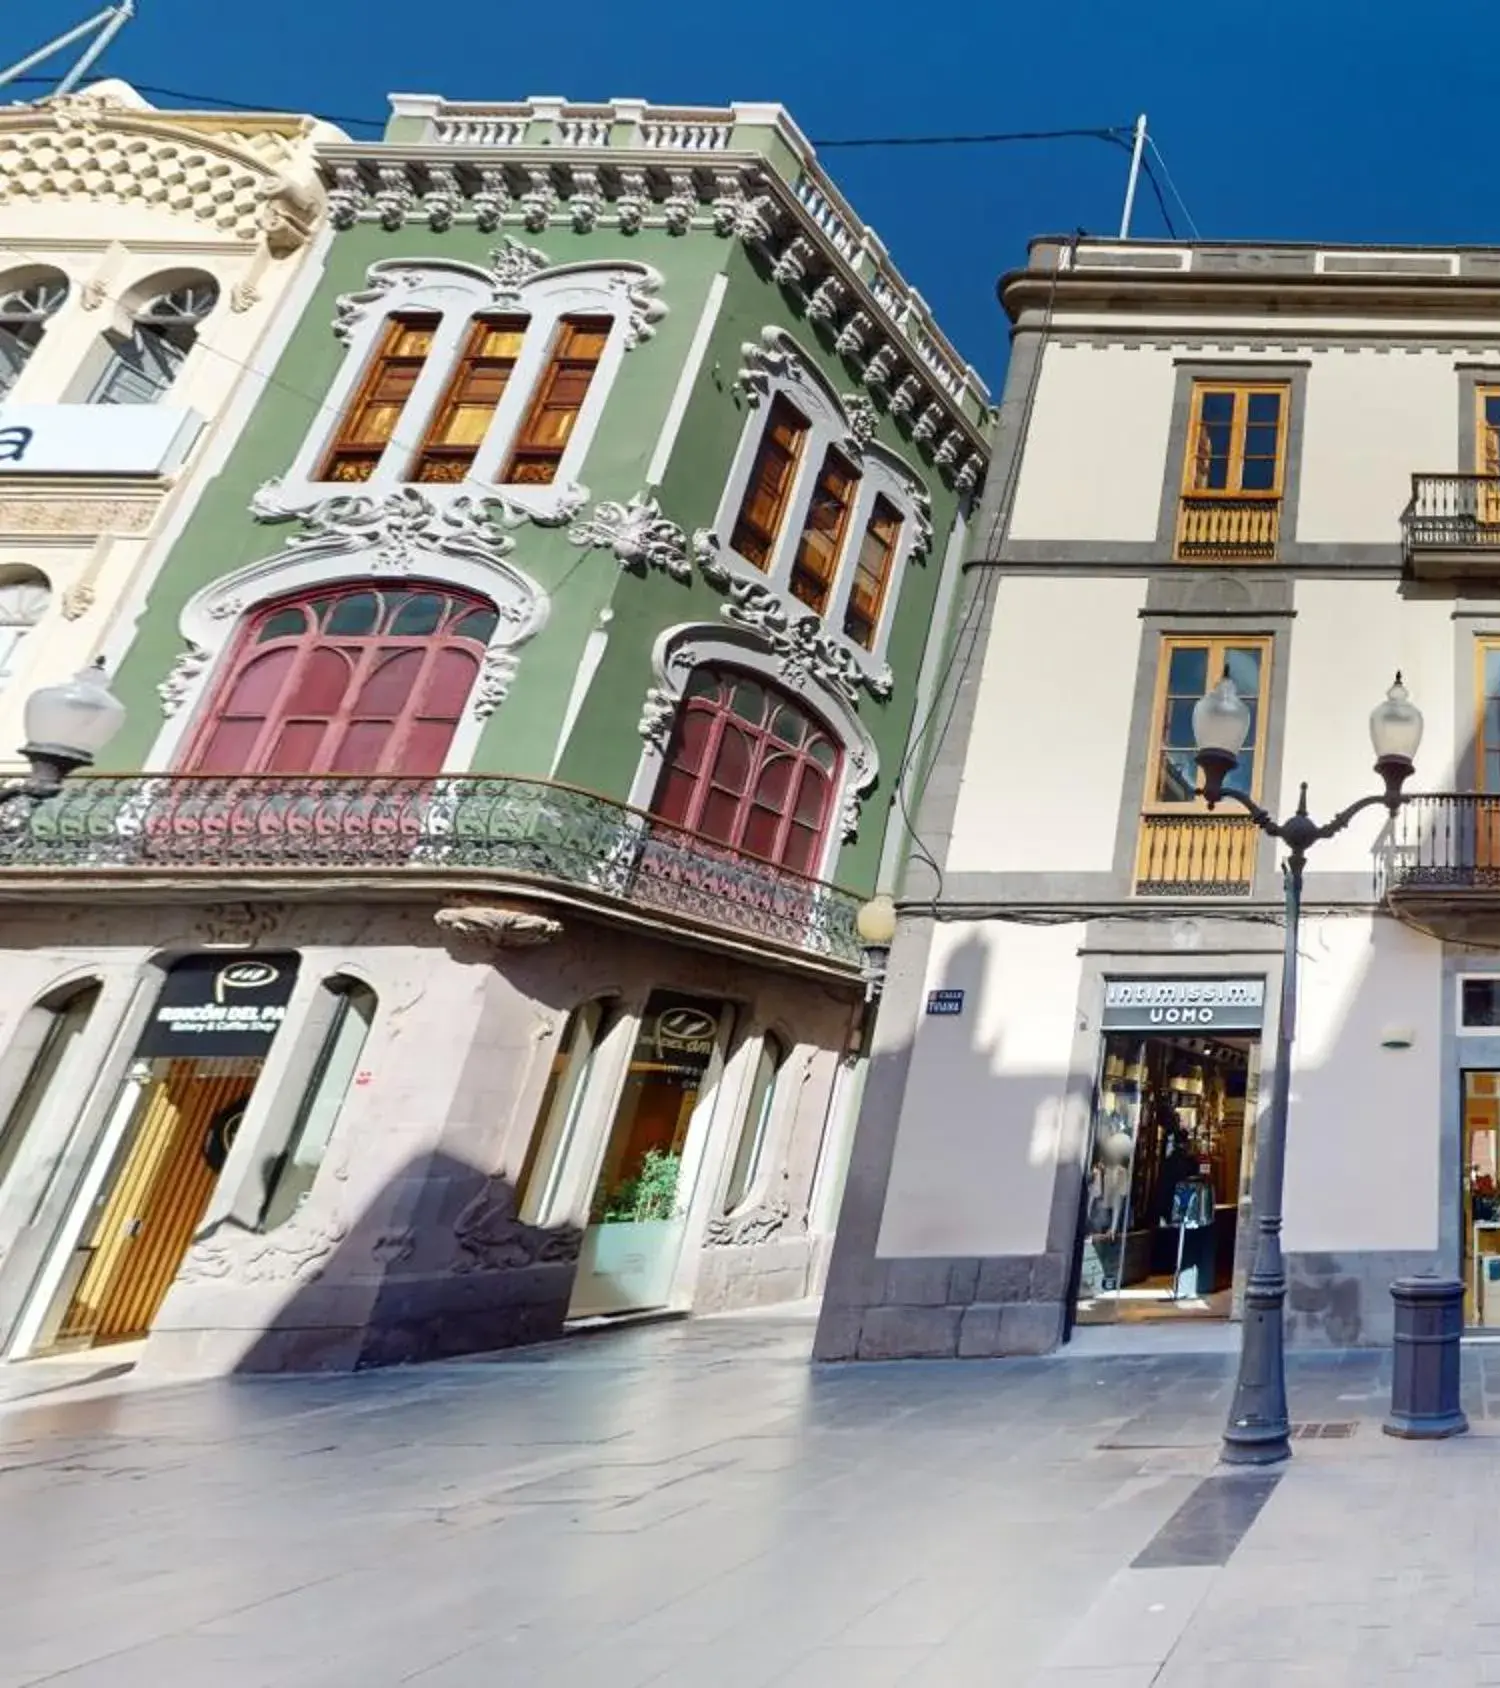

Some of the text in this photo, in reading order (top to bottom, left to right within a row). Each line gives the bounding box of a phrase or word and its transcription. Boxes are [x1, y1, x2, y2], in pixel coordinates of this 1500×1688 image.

[227, 1006, 259, 1021] DEL
[261, 1007, 286, 1021] PA
[1151, 1008, 1213, 1023] UOMO
